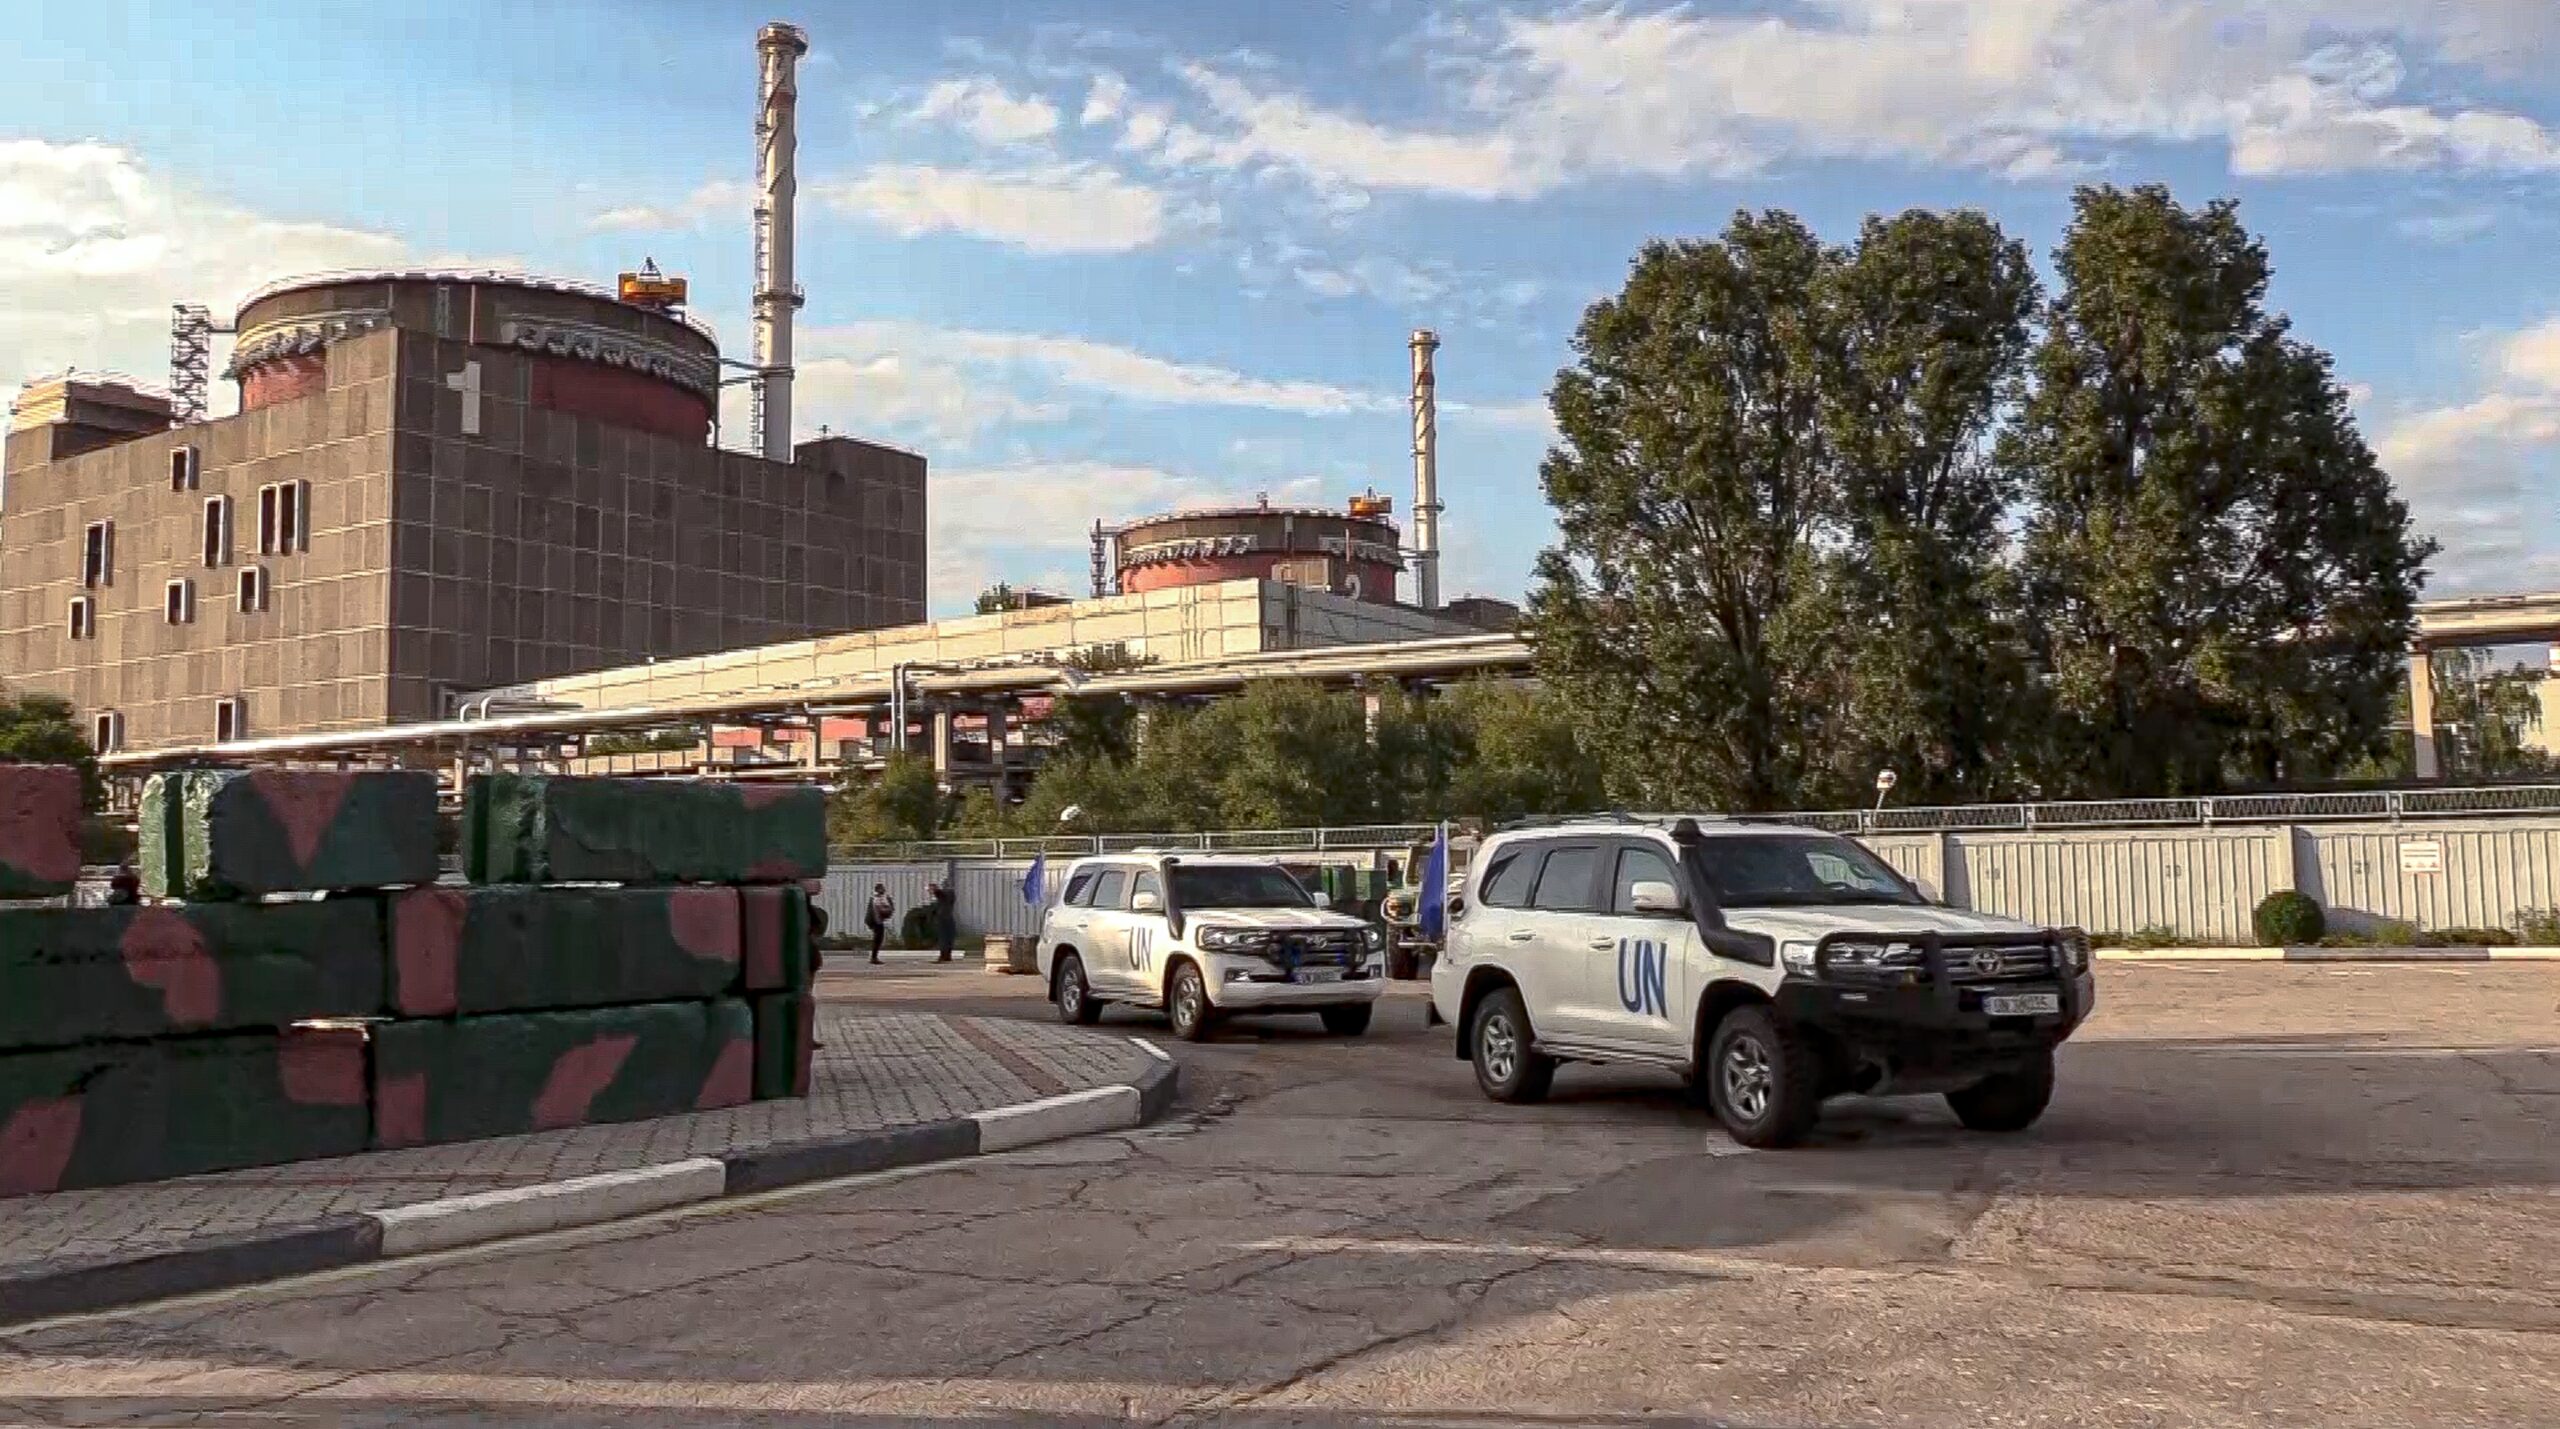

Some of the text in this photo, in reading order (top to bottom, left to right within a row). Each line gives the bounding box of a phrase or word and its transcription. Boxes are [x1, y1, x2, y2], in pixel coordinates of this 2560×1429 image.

[447, 361, 481, 434] 1
[1129, 926, 1153, 972] UN
[1618, 938, 1668, 1019] UN
